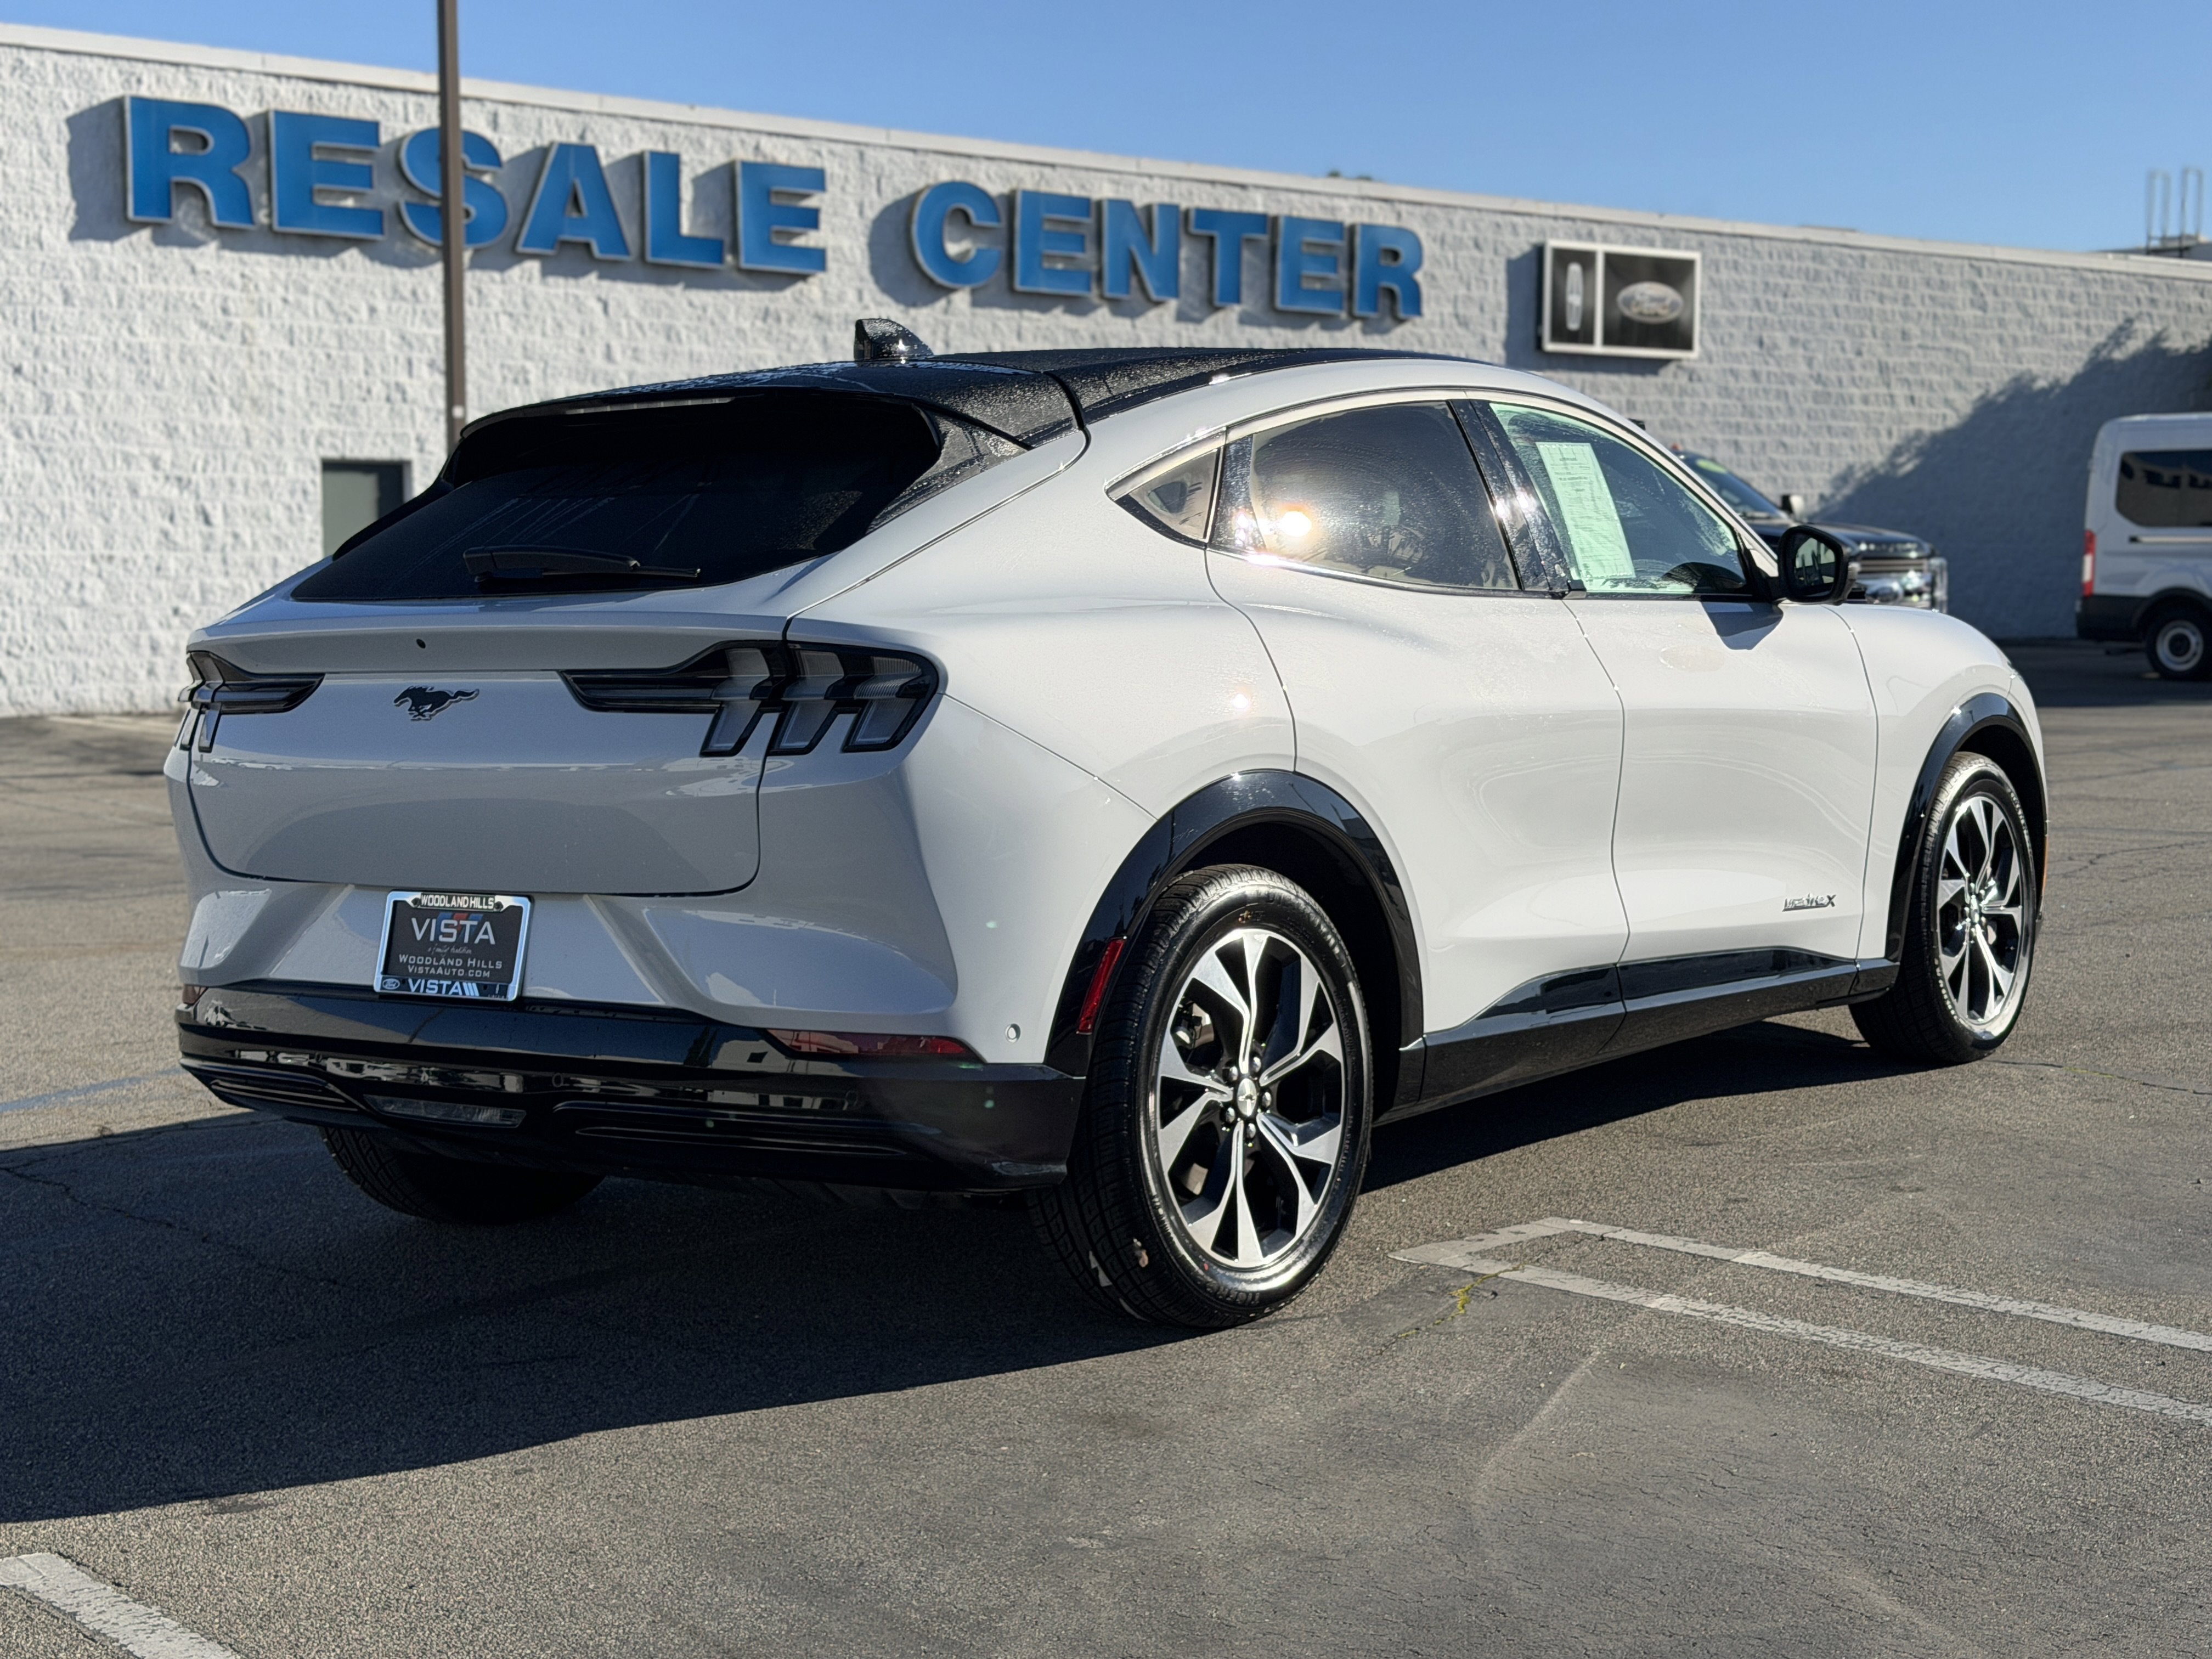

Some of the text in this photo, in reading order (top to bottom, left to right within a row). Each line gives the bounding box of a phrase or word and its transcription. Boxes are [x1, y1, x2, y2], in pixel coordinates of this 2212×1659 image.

[124, 95, 1424, 319] RESALE CENTER
[421, 894, 494, 909] WOODLAND HILLS
[411, 917, 495, 945] VISTA
[399, 953, 503, 969] WOODLAND HILLS
[408, 978, 463, 996] VISTA
